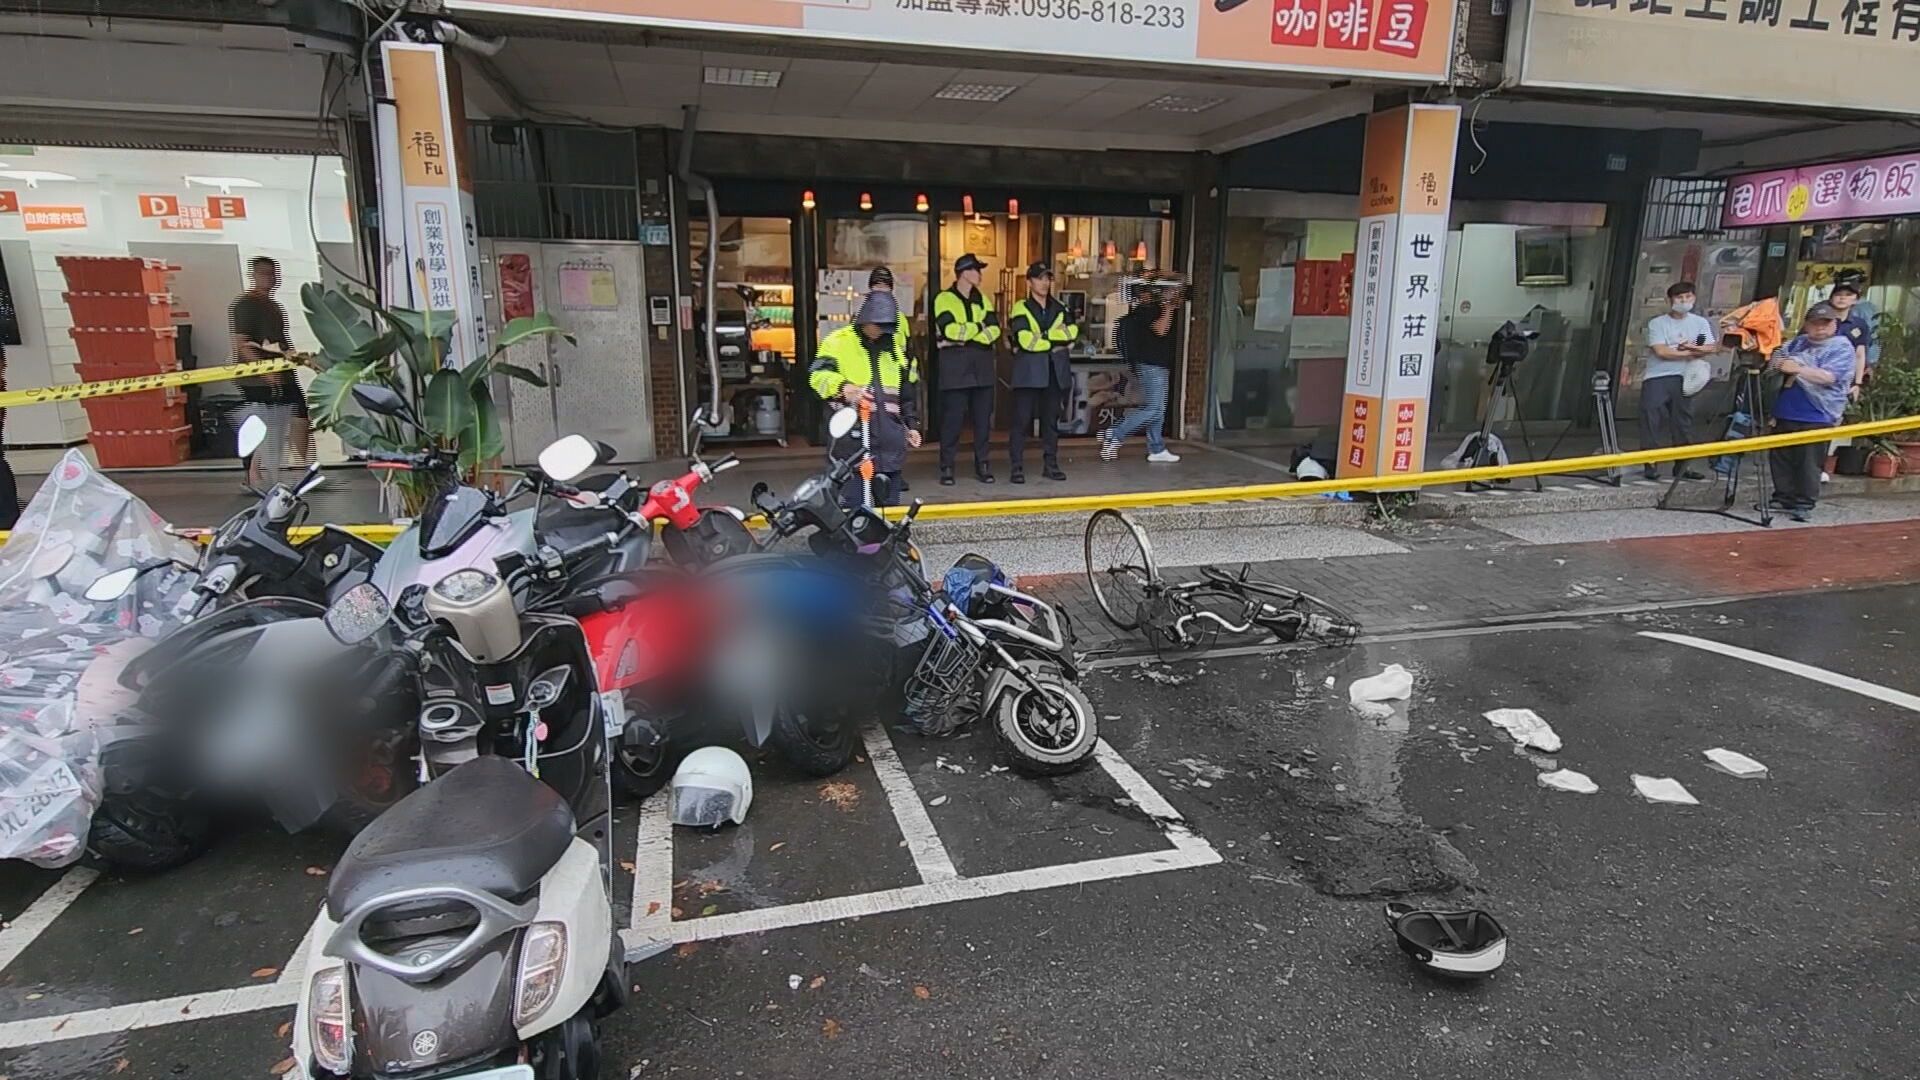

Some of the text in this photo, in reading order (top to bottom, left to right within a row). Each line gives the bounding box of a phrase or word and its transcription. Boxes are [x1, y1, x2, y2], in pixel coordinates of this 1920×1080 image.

[1276, 0, 1415, 49] 咖啡豆
[408, 131, 440, 158] 福
[424, 161, 443, 176] Fu
[1417, 172, 1437, 192] 福
[150, 197, 168, 215] D
[220, 199, 235, 216] E
[1427, 196, 1438, 206] Fu
[424, 209, 447, 272] 創業教學
[432, 277, 451, 307] 現烘
[1399, 233, 1434, 376] 世界莊園
[1361, 350, 1370, 381] shop
[1351, 403, 1367, 465] 咖啡豆
[1394, 406, 1414, 469] 咖啡豆
